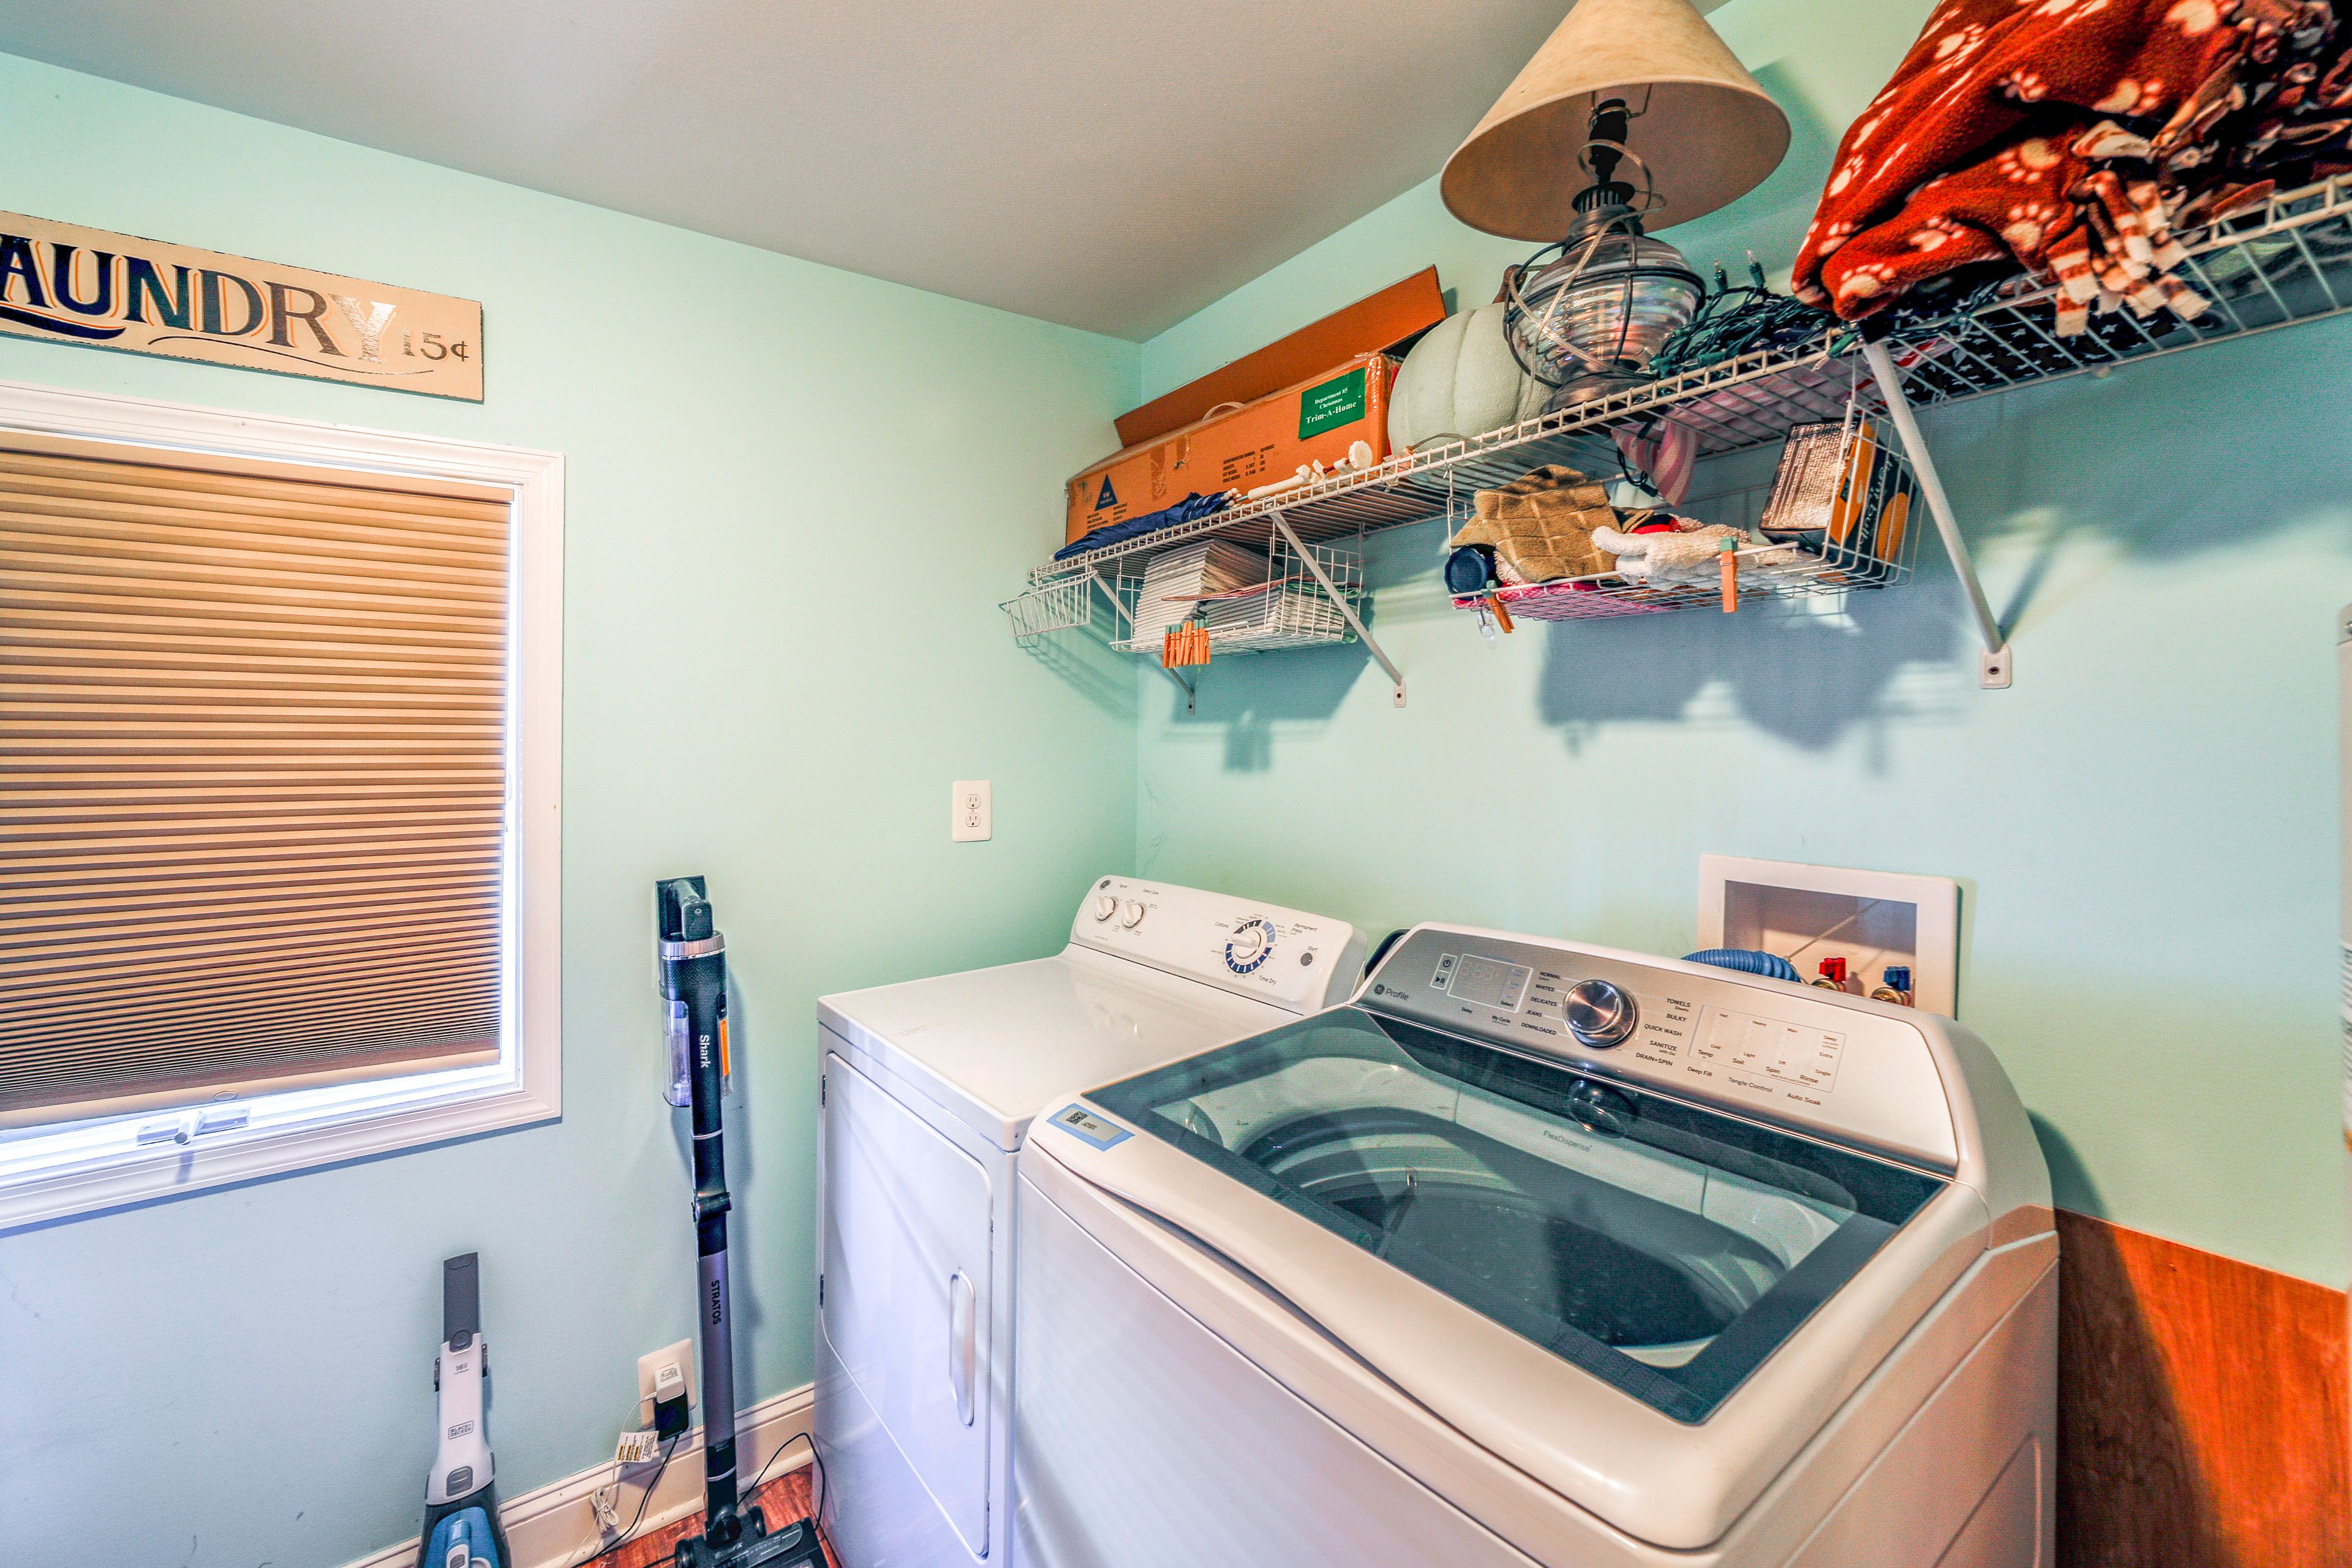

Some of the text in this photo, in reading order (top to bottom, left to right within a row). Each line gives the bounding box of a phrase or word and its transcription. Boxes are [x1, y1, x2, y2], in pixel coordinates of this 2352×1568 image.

[0, 232, 398, 365] AUNDRY
[1314, 391, 1341, 404] Department
[1319, 398, 1343, 409] Christmas
[1305, 402, 1357, 424] Trim-A-Home
[1294, 923, 1317, 932] Permanent
[1540, 971, 1561, 980] NORMAL
[1385, 988, 1409, 1001] Profile
[1531, 997, 1558, 1006] DELICATES
[1667, 998, 1691, 1008] TOWELS
[1666, 1013, 1687, 1022] BULKY
[1521, 1022, 1556, 1035] DOWNLOADED
[1644, 1023, 1682, 1036] QUICK WASH
[1649, 1040, 1678, 1051] SANITIZE
[699, 1034, 711, 1069] Shark
[1698, 1049, 1714, 1058] Temp
[1635, 1052, 1673, 1066] DRAIN+SPIN
[1687, 1066, 1702, 1075] Deep
[1728, 1077, 1773, 1092] Tangle Control
[1800, 1074, 1819, 1084] Rinse
[1804, 1097, 1822, 1106] Soak
[711, 1280, 722, 1325] STRATOS
[450, 1427, 471, 1437] DECKER
